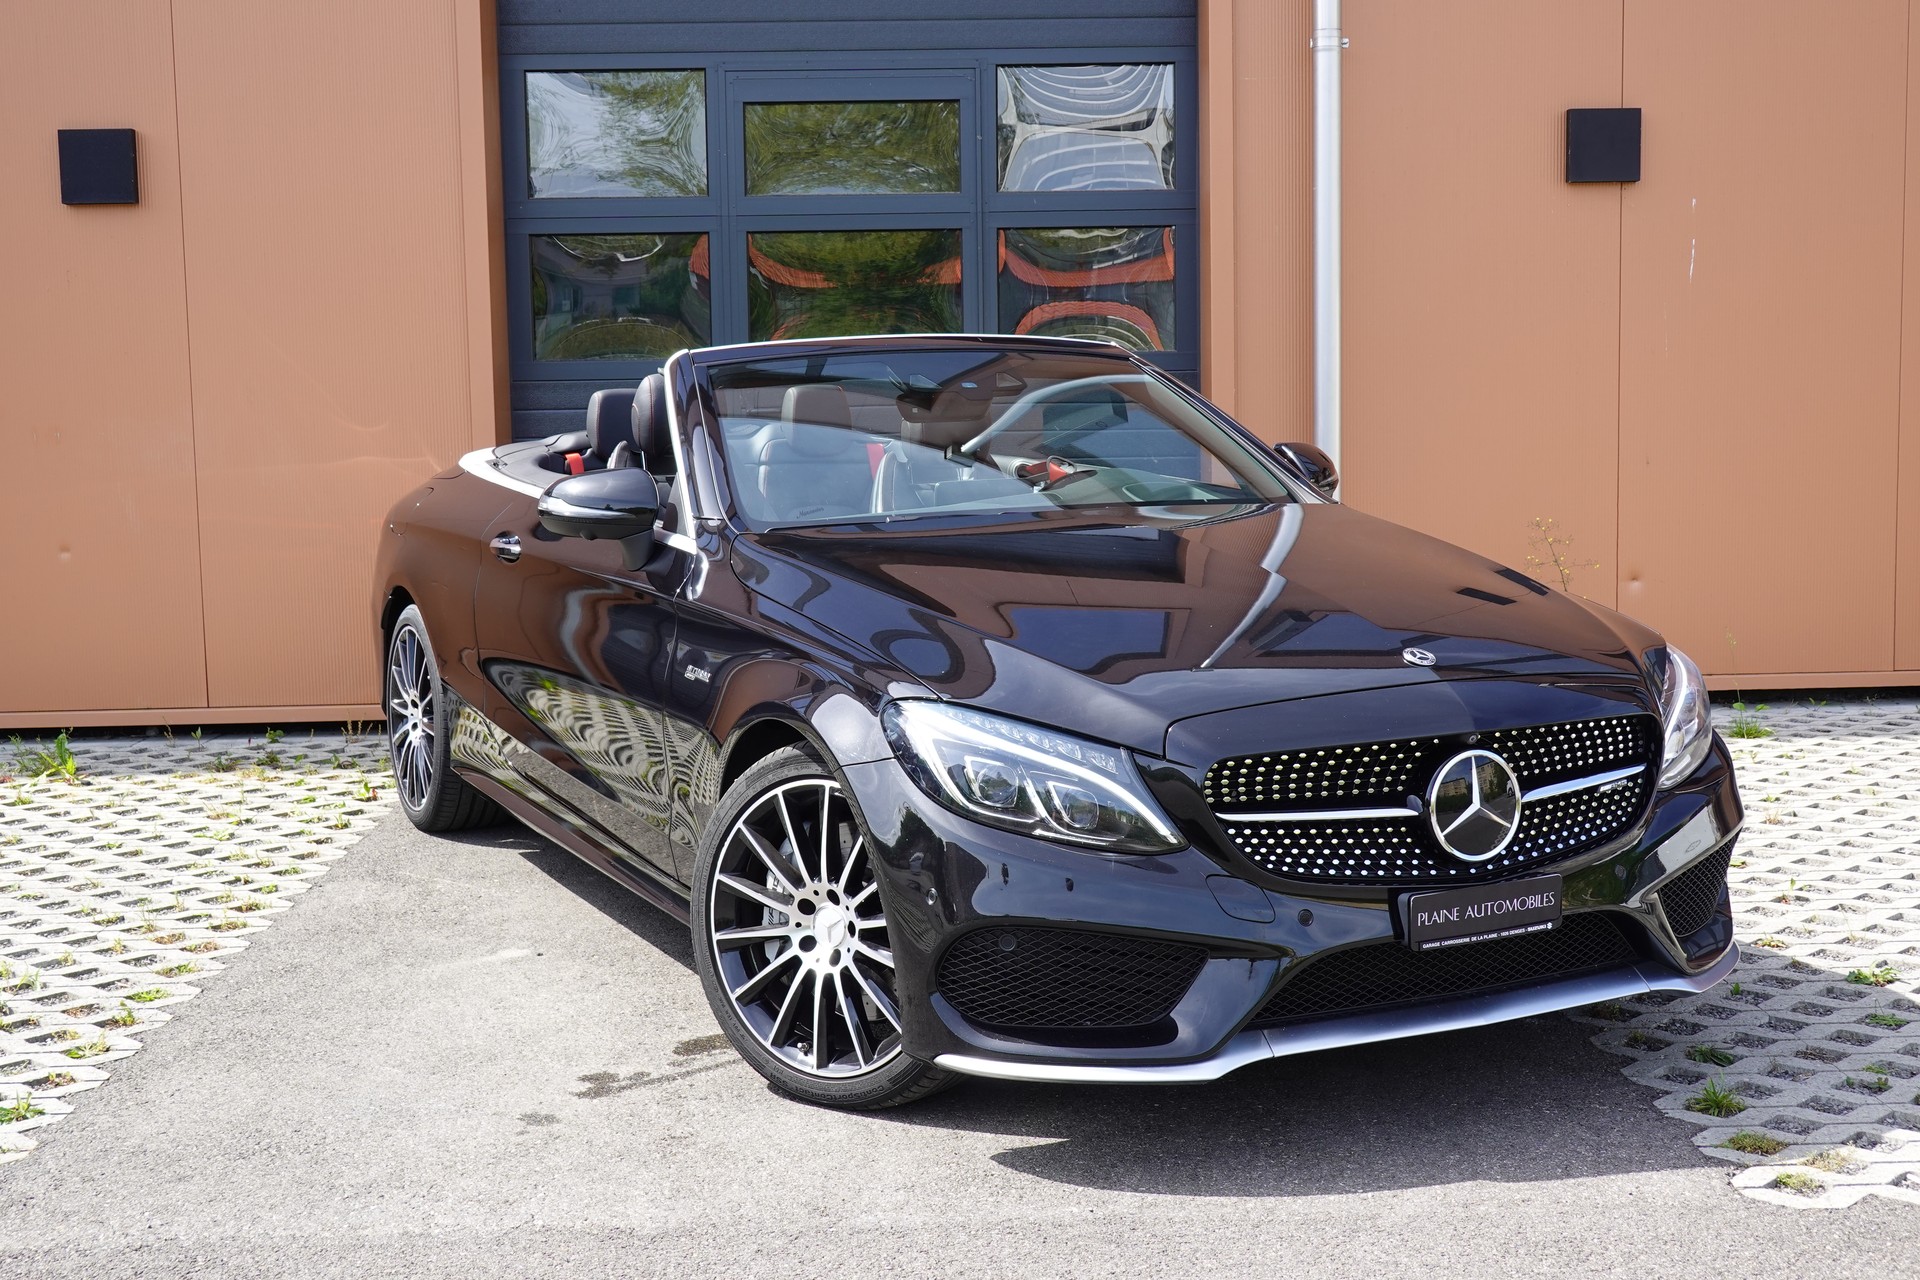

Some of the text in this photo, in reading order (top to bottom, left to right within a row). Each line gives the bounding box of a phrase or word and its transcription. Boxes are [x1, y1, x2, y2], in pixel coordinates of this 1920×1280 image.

[1417, 891, 1555, 926] PLAINE AUTOMOBILES
[1441, 937, 1470, 946] CARROSSERIE
[1483, 932, 1498, 940] PLAINE
[1509, 928, 1526, 936] DENGES
[1527, 924, 1547, 932] SUZUKI
[795, 1084, 885, 1101] ContiSportContact
